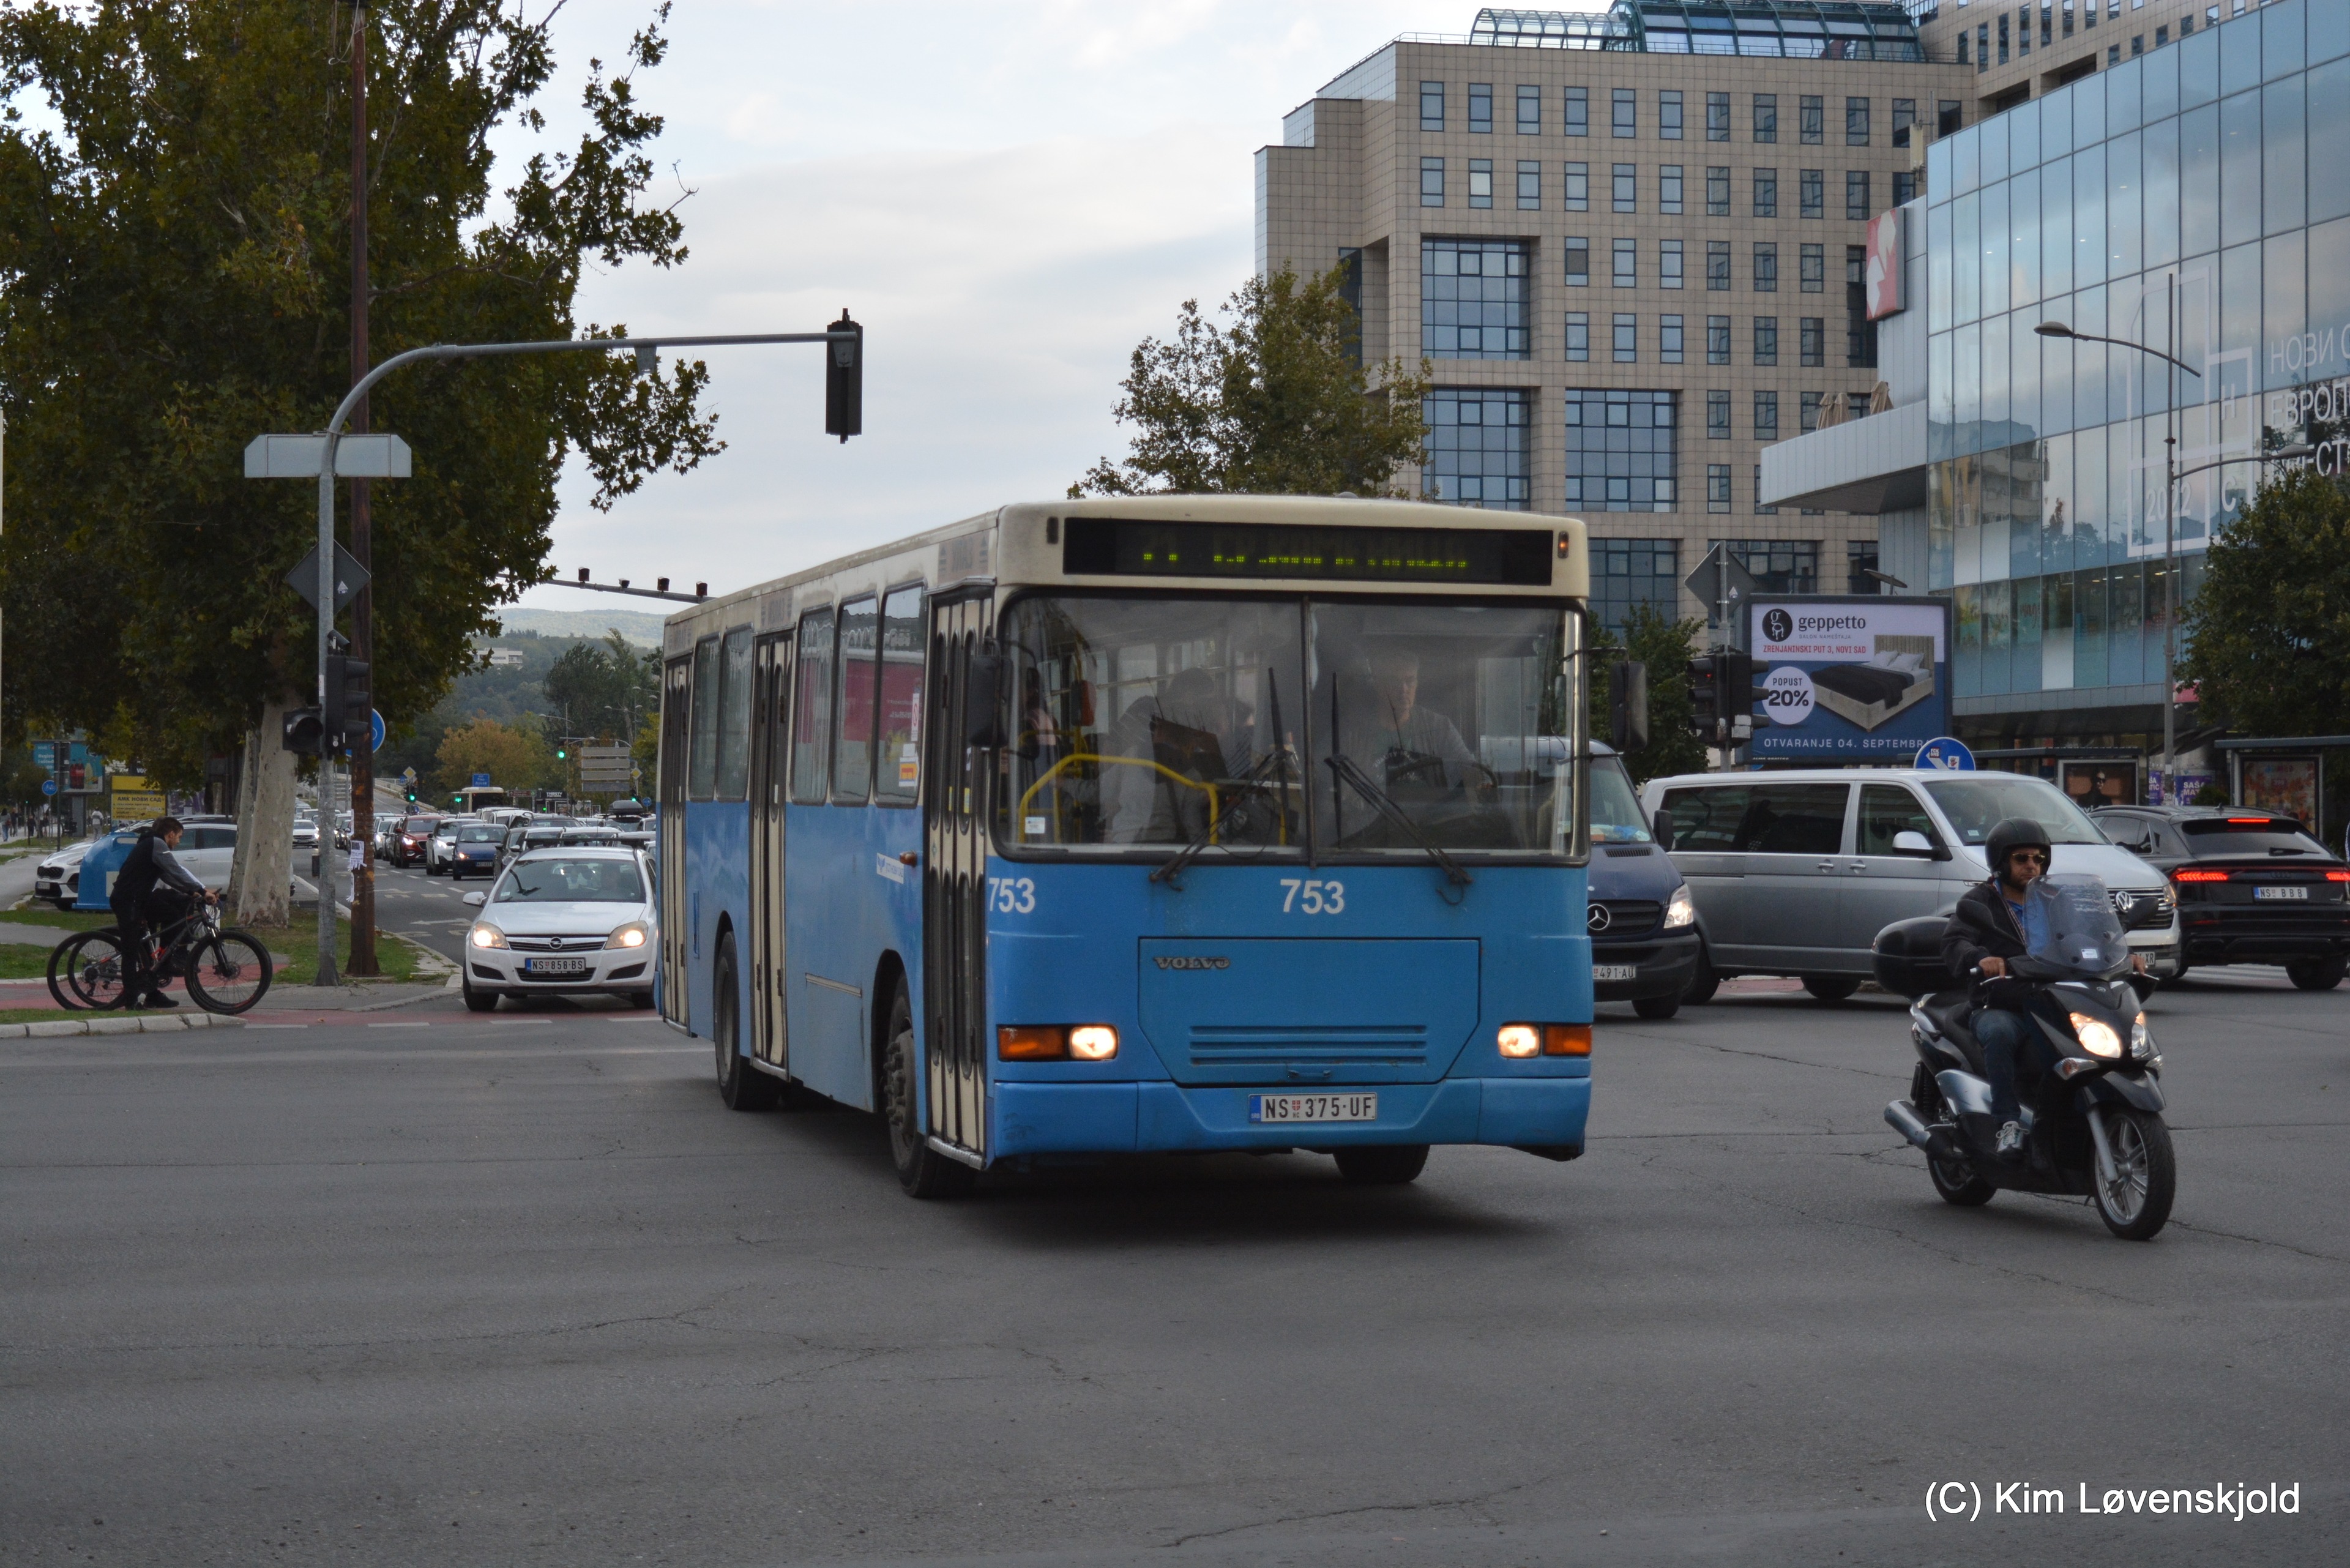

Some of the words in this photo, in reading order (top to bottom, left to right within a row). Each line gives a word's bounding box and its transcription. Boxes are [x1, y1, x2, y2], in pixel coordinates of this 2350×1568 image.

[2270, 329, 2333, 374] НОВИ
[2270, 382, 2350, 428] ЕВРОП
[2146, 482, 2191, 523] 2022
[1798, 616, 1866, 632] geppetto
[1768, 690, 1809, 707] 20%
[1764, 739, 1832, 747] OTVARANJE
[1838, 739, 1857, 748] 04.
[988, 878, 1035, 913] 753
[1280, 879, 1345, 914] 753
[2260, 889, 2271, 897] NS
[532, 960, 543, 969] NS
[1153, 957, 1231, 969] VOLVO
[1265, 1099, 1288, 1118] NS
